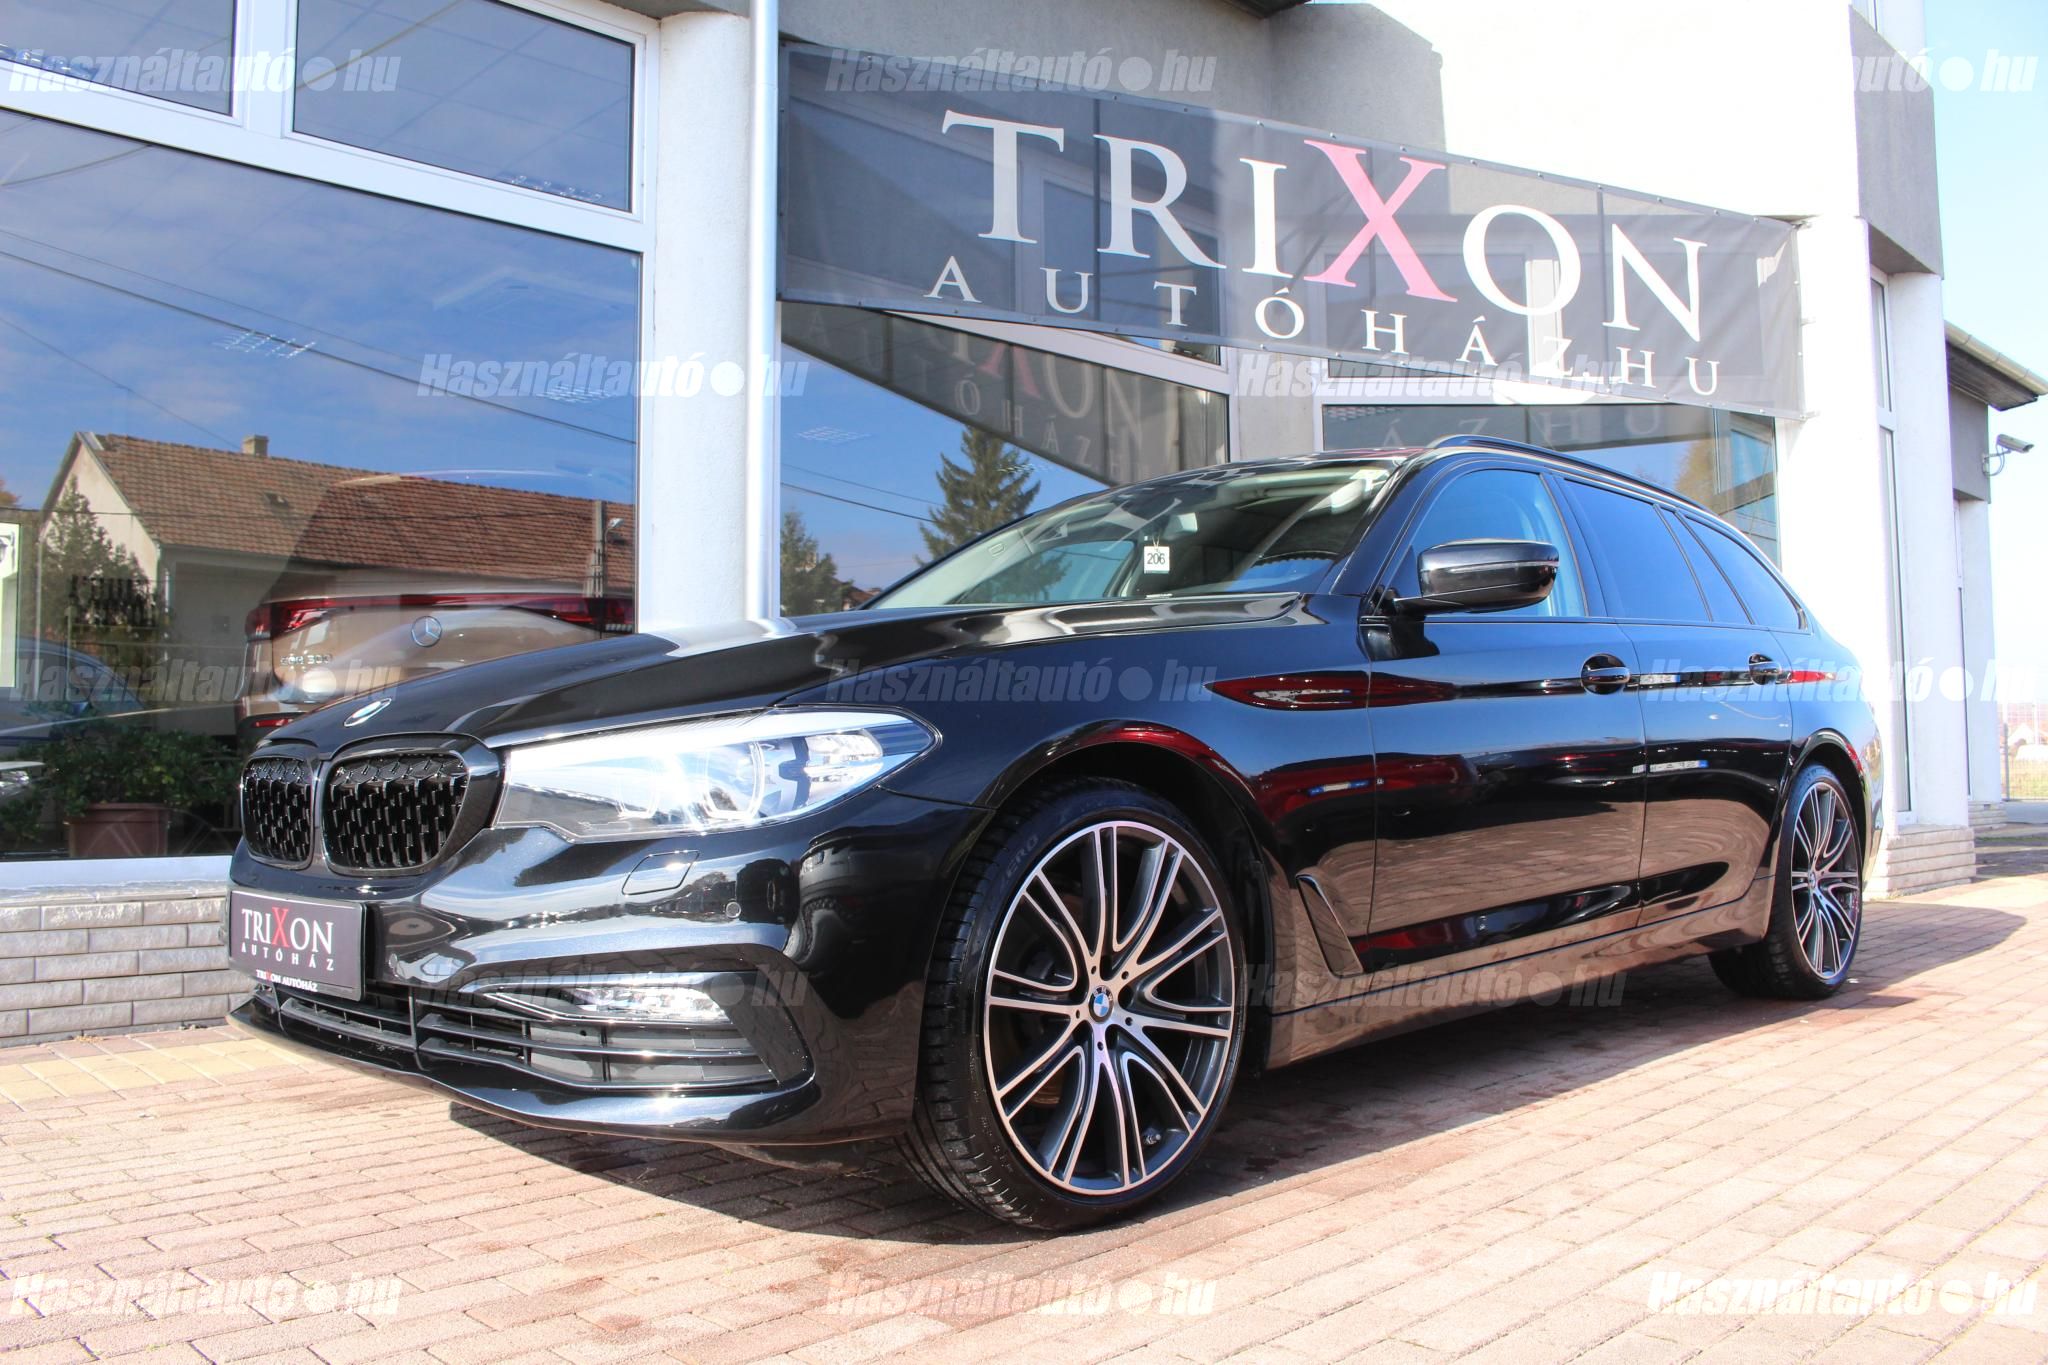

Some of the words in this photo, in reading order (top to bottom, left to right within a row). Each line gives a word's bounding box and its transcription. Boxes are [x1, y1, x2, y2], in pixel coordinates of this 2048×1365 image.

[940, 109, 1708, 343] TRIXON
[1146, 552, 1166, 565] 206
[241, 906, 334, 955] TRIXON
[241, 942, 335, 971] AUTÓHÁZ
[255, 969, 282, 984] TRIXON
[282, 976, 318, 992] AUTÓHÁZ
